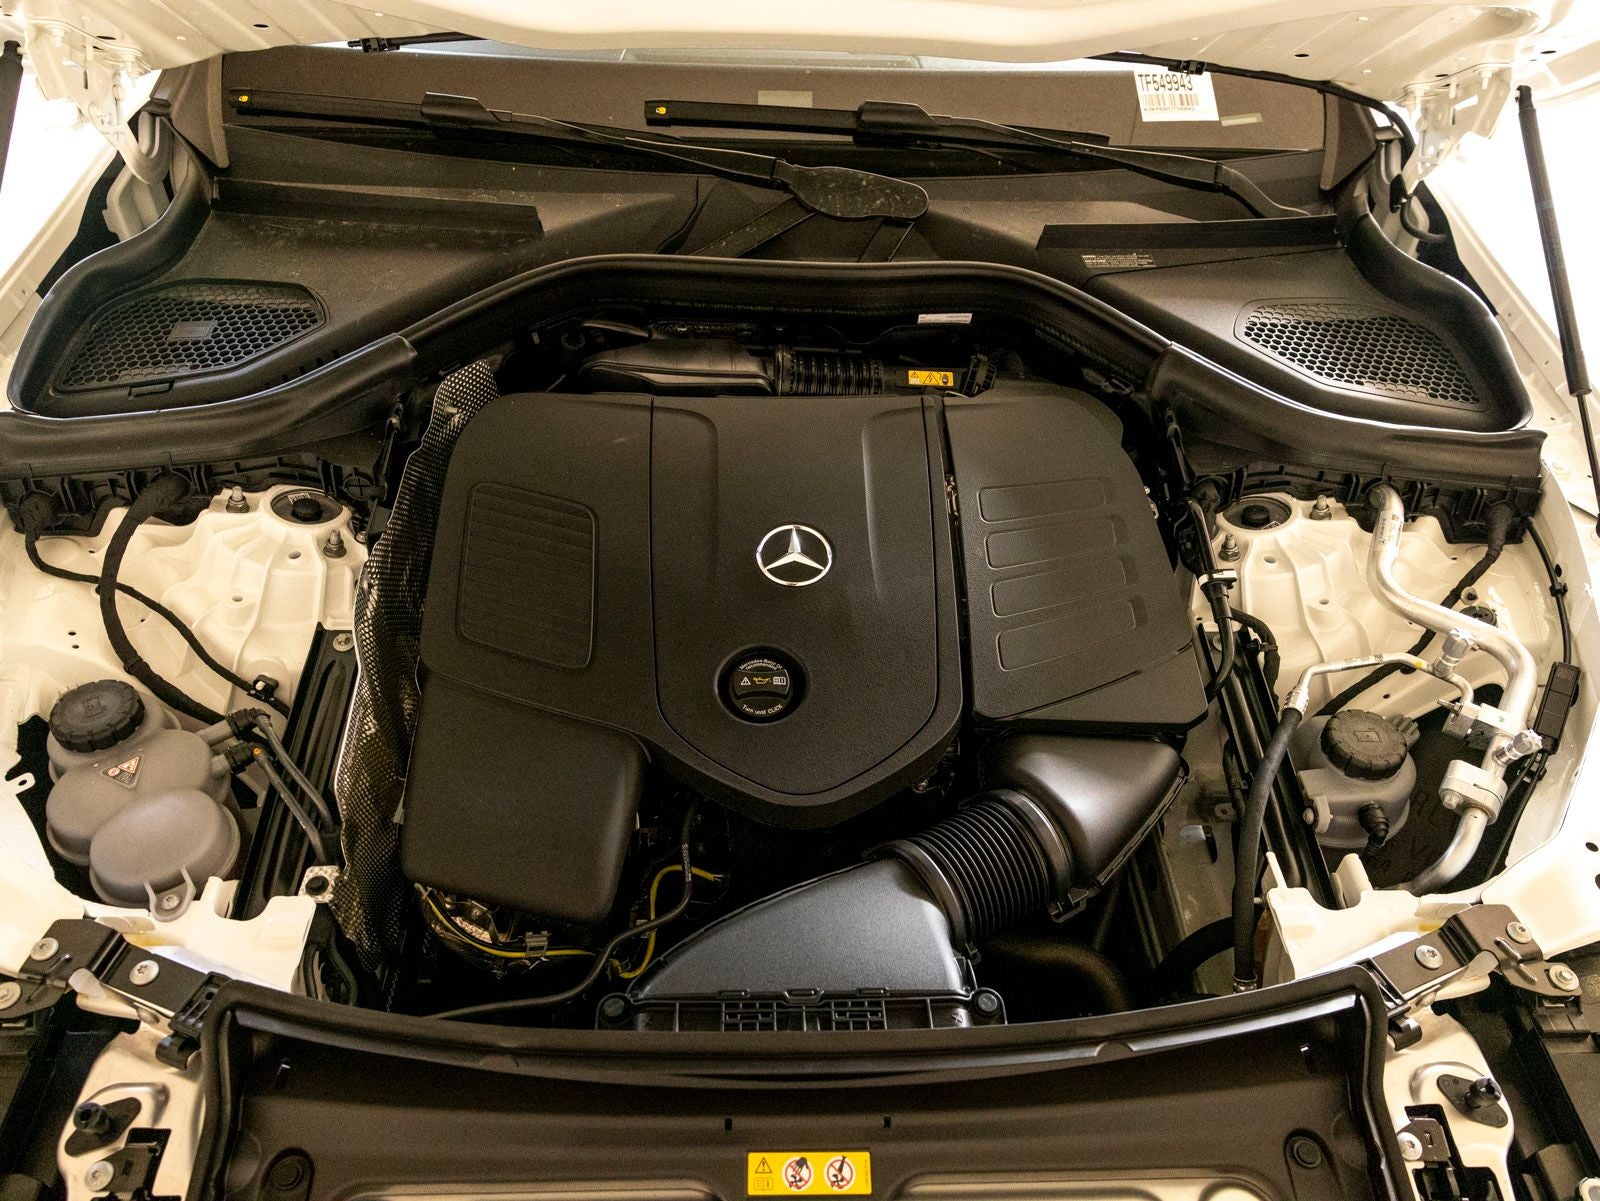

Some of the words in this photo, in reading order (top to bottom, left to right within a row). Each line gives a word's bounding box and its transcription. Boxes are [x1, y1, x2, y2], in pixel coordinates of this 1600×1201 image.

[1138, 74, 1193, 91] TF549943
[743, 704, 754, 713] Turn
[768, 704, 783, 714] CLICK
